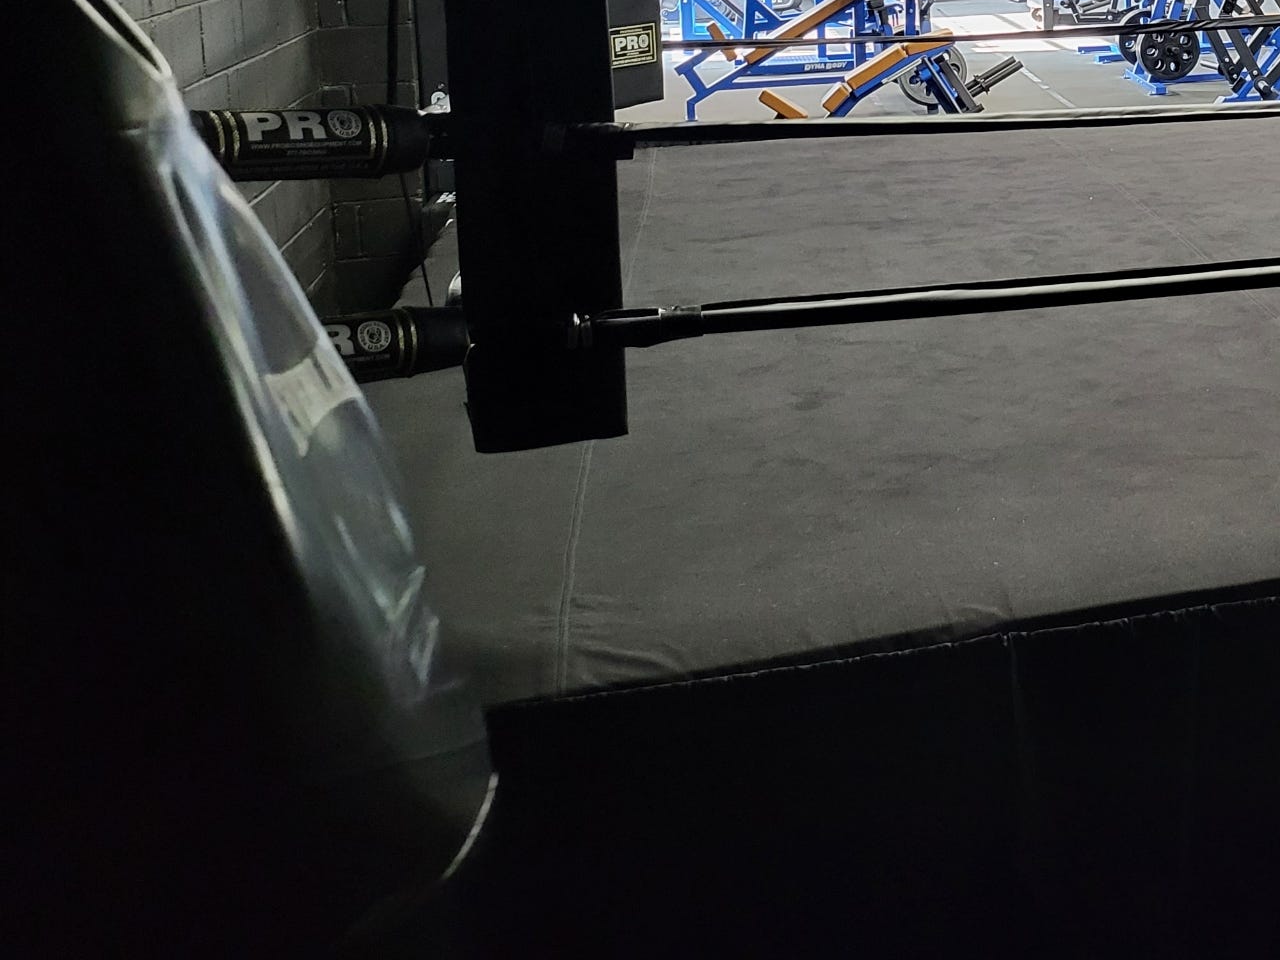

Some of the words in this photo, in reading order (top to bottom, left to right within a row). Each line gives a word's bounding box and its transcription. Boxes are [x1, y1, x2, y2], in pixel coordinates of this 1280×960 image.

[615, 34, 649, 52] PRO
[240, 110, 362, 142] PRO
[324, 321, 391, 352] RO
